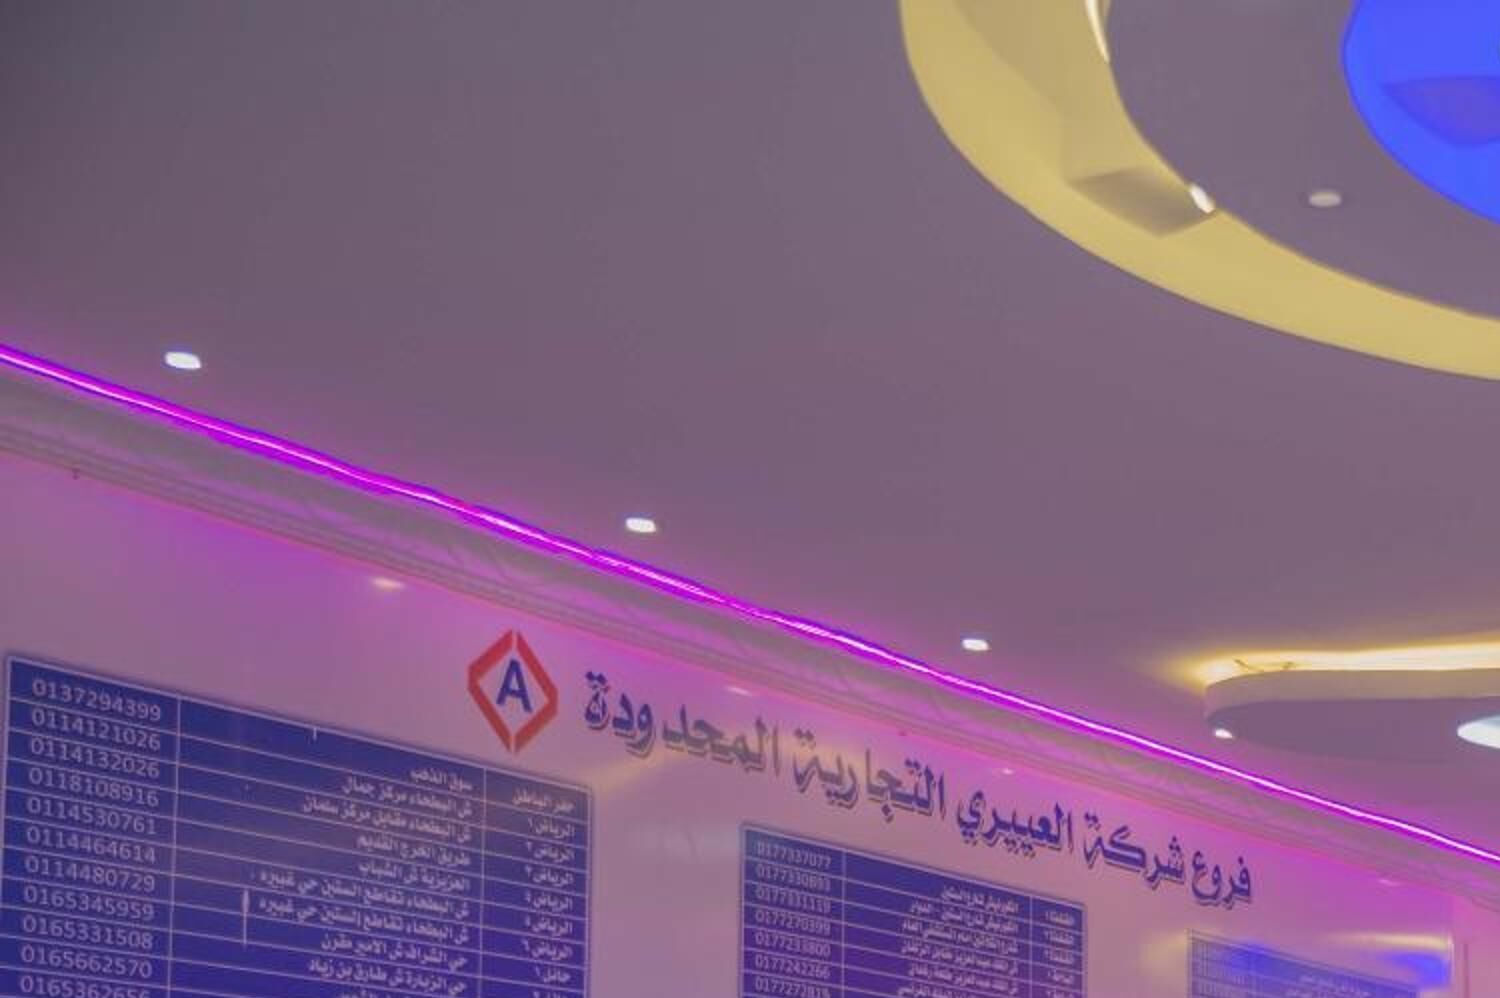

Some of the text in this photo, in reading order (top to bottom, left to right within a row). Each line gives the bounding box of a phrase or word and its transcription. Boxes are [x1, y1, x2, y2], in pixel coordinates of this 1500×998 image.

[496, 659, 533, 713] A
[31, 706, 160, 751] 0114121026
[29, 737, 160, 778] 0114132026
[792, 729, 947, 823] التجارية
[24, 854, 155, 892] 0114480729
[1083, 811, 1185, 891] شركة
[1191, 850, 1253, 909] فروع
[21, 913, 153, 950] 0165331508
[20, 943, 152, 978] 0165662570
